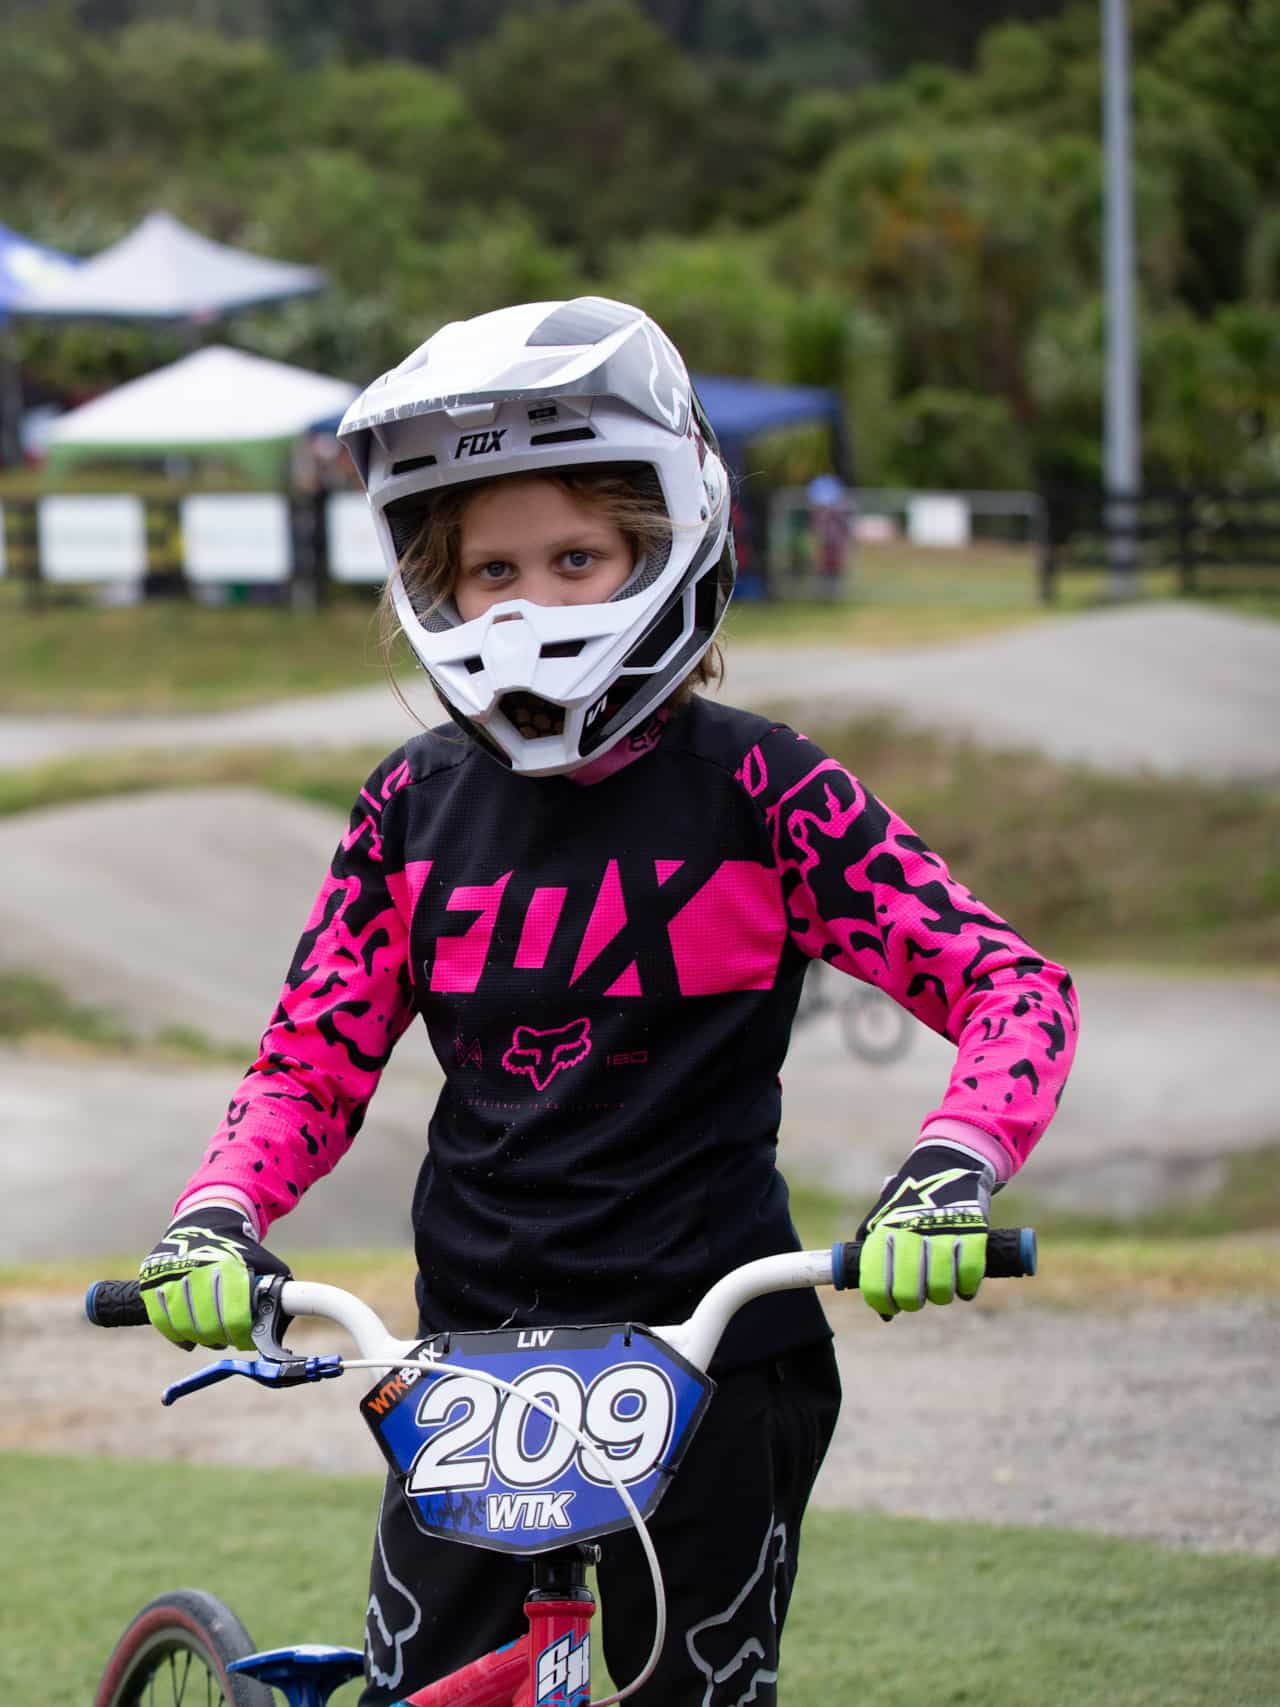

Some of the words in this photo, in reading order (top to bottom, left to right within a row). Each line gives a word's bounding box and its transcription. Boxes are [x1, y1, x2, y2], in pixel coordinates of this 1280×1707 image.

[454, 428, 510, 461] FOX
[410, 858, 725, 997] FOX
[516, 1330, 554, 1348] LIV
[405, 1361, 676, 1496] 209
[486, 1491, 576, 1531] WTK
